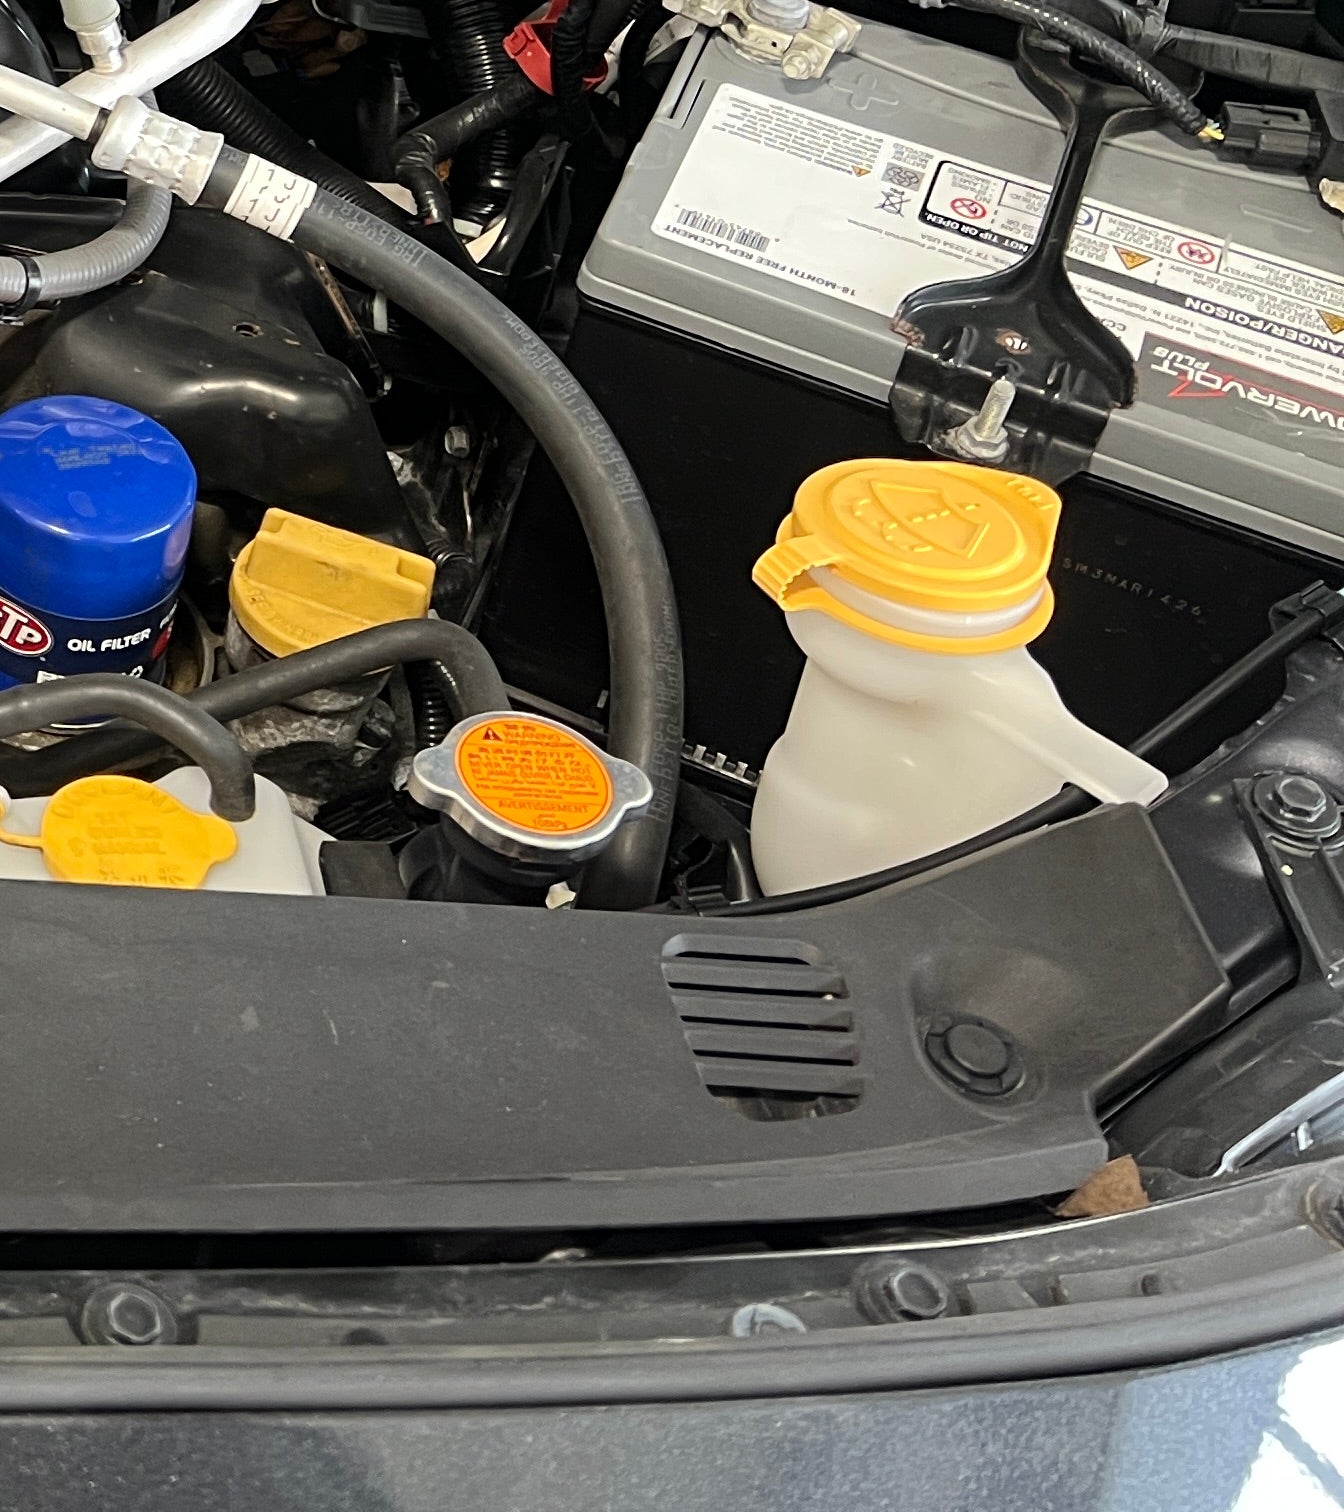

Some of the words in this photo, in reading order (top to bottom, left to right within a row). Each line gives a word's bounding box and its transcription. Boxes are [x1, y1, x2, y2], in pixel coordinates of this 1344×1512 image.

[662, 223, 754, 260] REPLACEMENT
[958, 224, 979, 236] OR
[977, 230, 1000, 243] TIP
[754, 255, 787, 272] FREE
[1183, 295, 1344, 355] ANGER/POISON
[1151, 344, 1210, 371] PLUS
[1148, 355, 1344, 431] WERVOLT
[67, 637, 96, 653] OIL
[100, 627, 152, 652] FILTER
